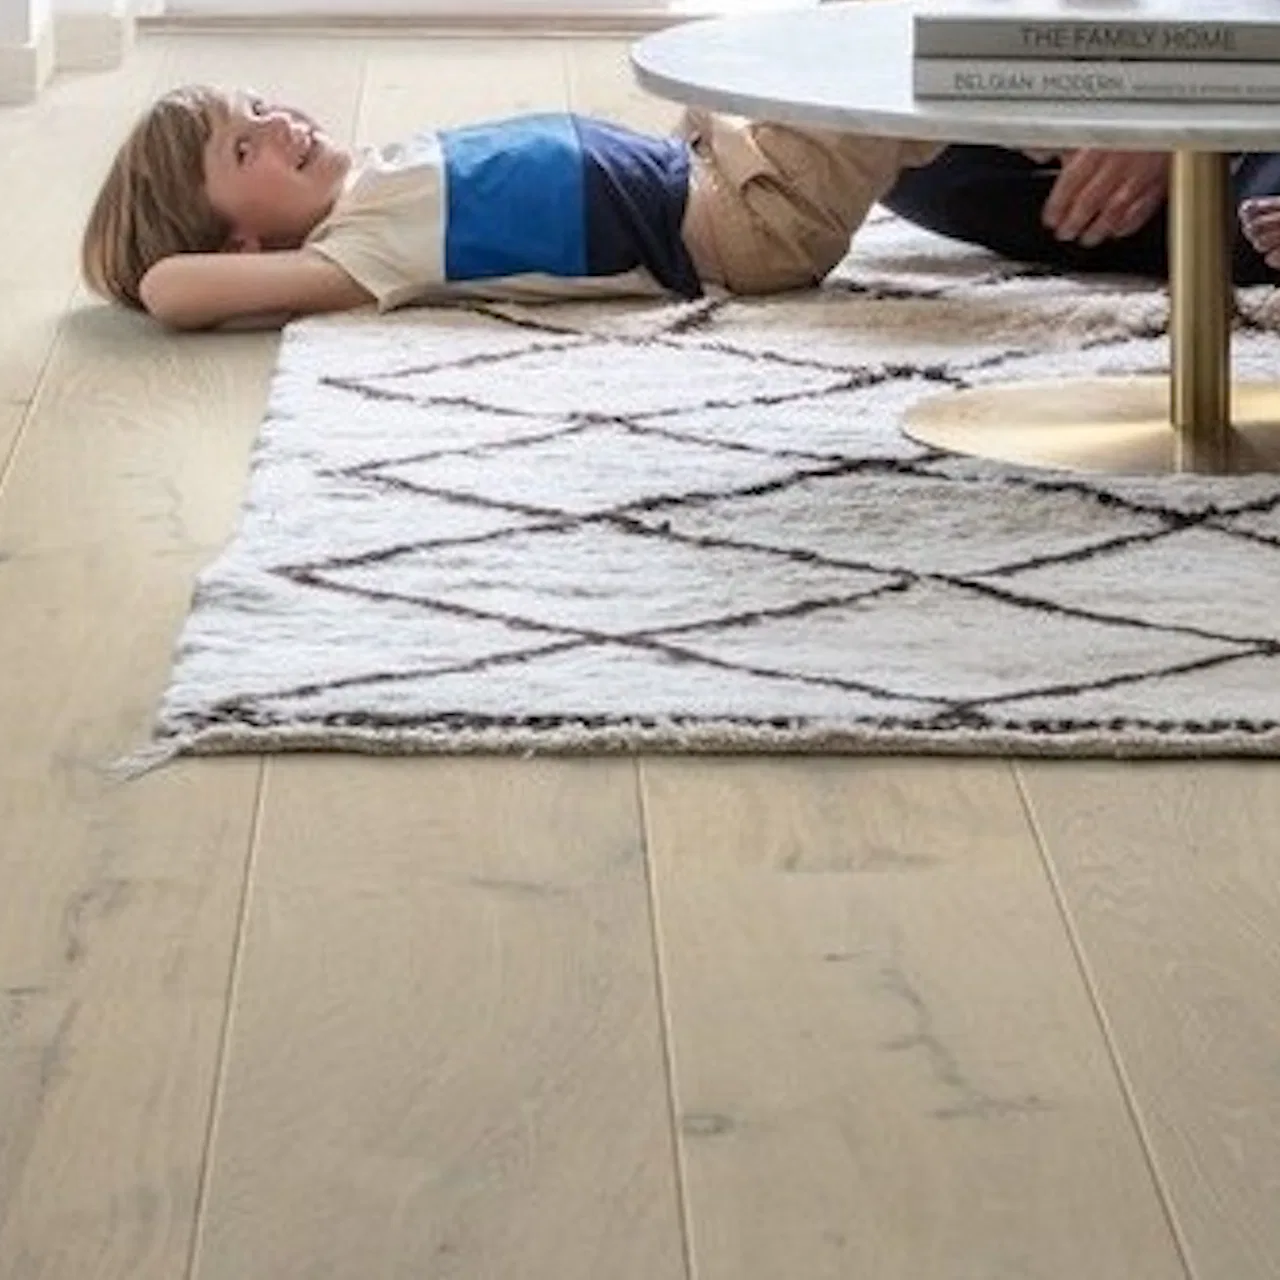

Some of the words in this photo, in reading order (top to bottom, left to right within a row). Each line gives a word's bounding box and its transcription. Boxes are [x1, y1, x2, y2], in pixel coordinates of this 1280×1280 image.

[1019, 28, 1072, 52] THE
[1073, 28, 1154, 52] FAMILY
[1161, 29, 1238, 52] HOME
[953, 71, 1034, 92] BELGIAN
[1041, 73, 1124, 92] MODERN
